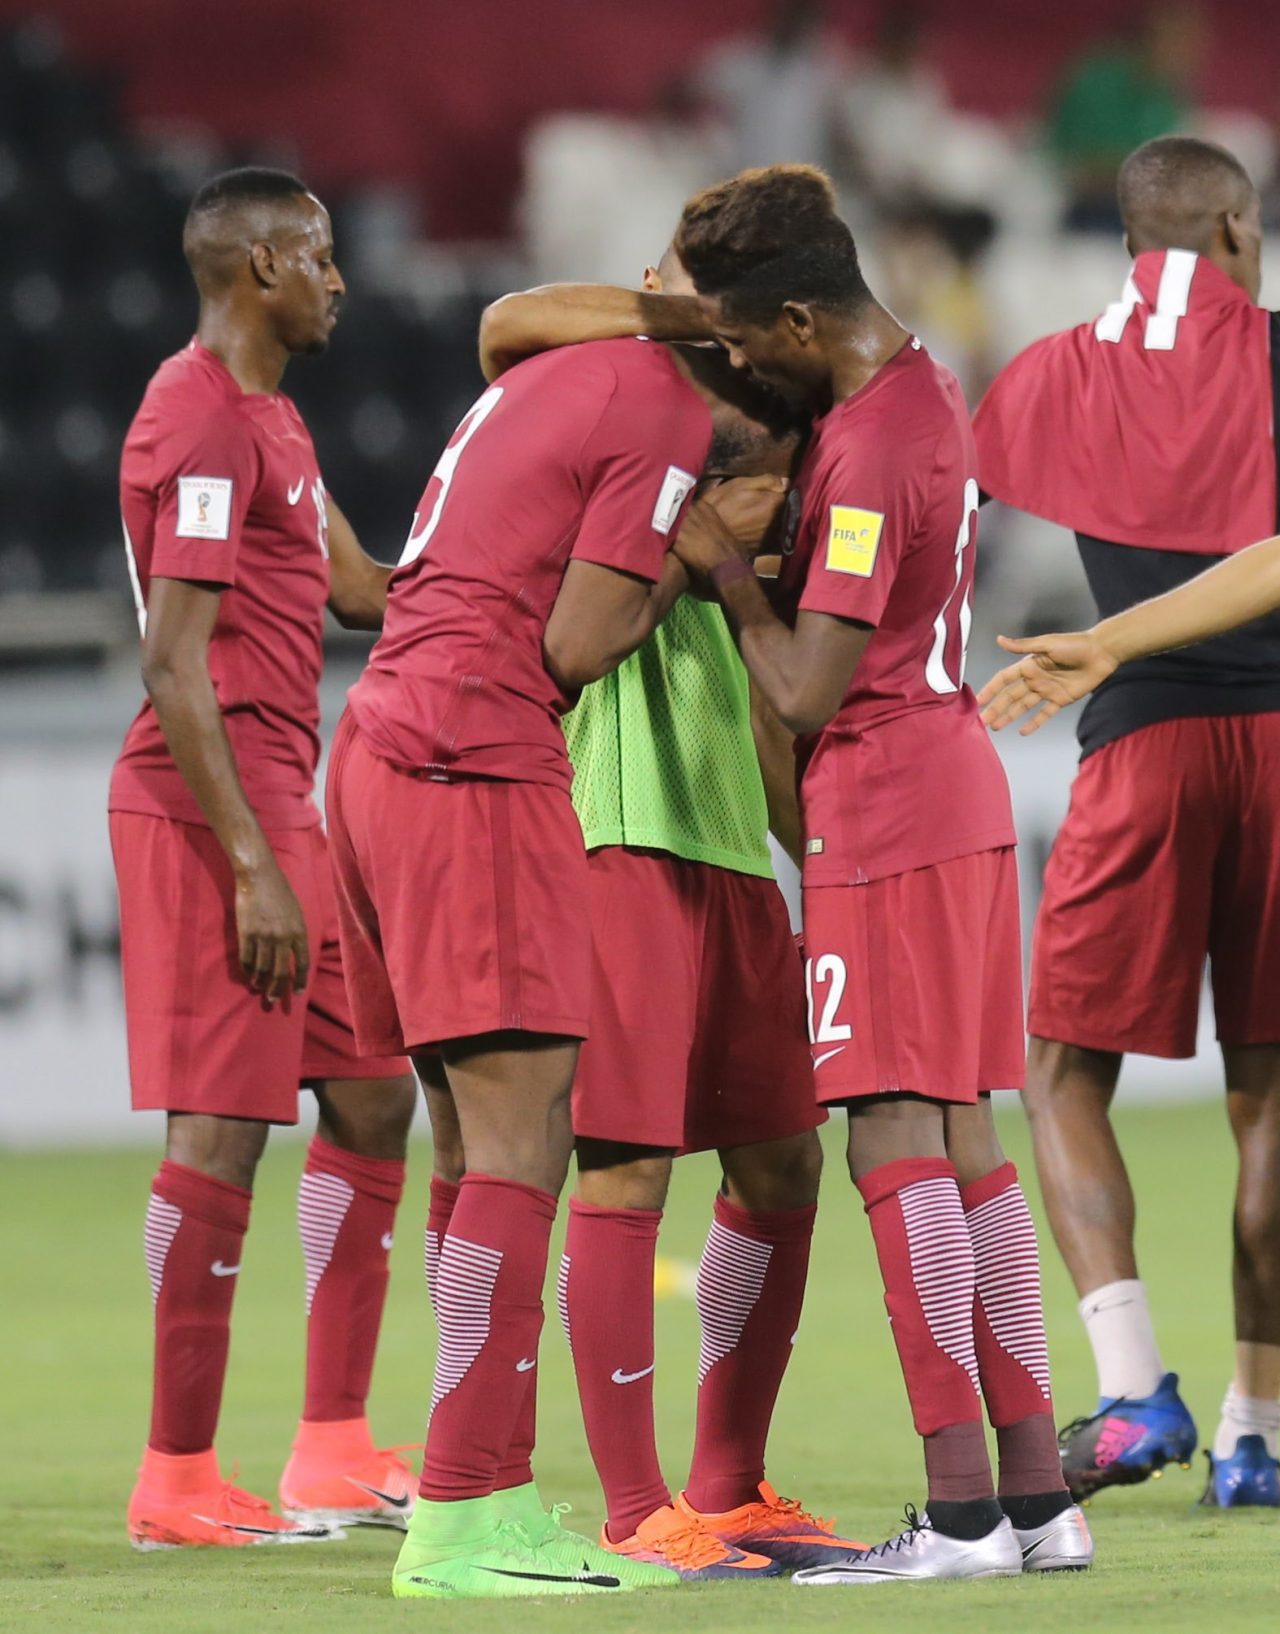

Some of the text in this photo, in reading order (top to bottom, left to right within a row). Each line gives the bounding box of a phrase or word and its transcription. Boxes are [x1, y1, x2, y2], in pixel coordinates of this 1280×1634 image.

[833, 528, 857, 542] FIFA
[804, 952, 853, 1045] 12
[408, 1575, 458, 1592] MERCURIAL
